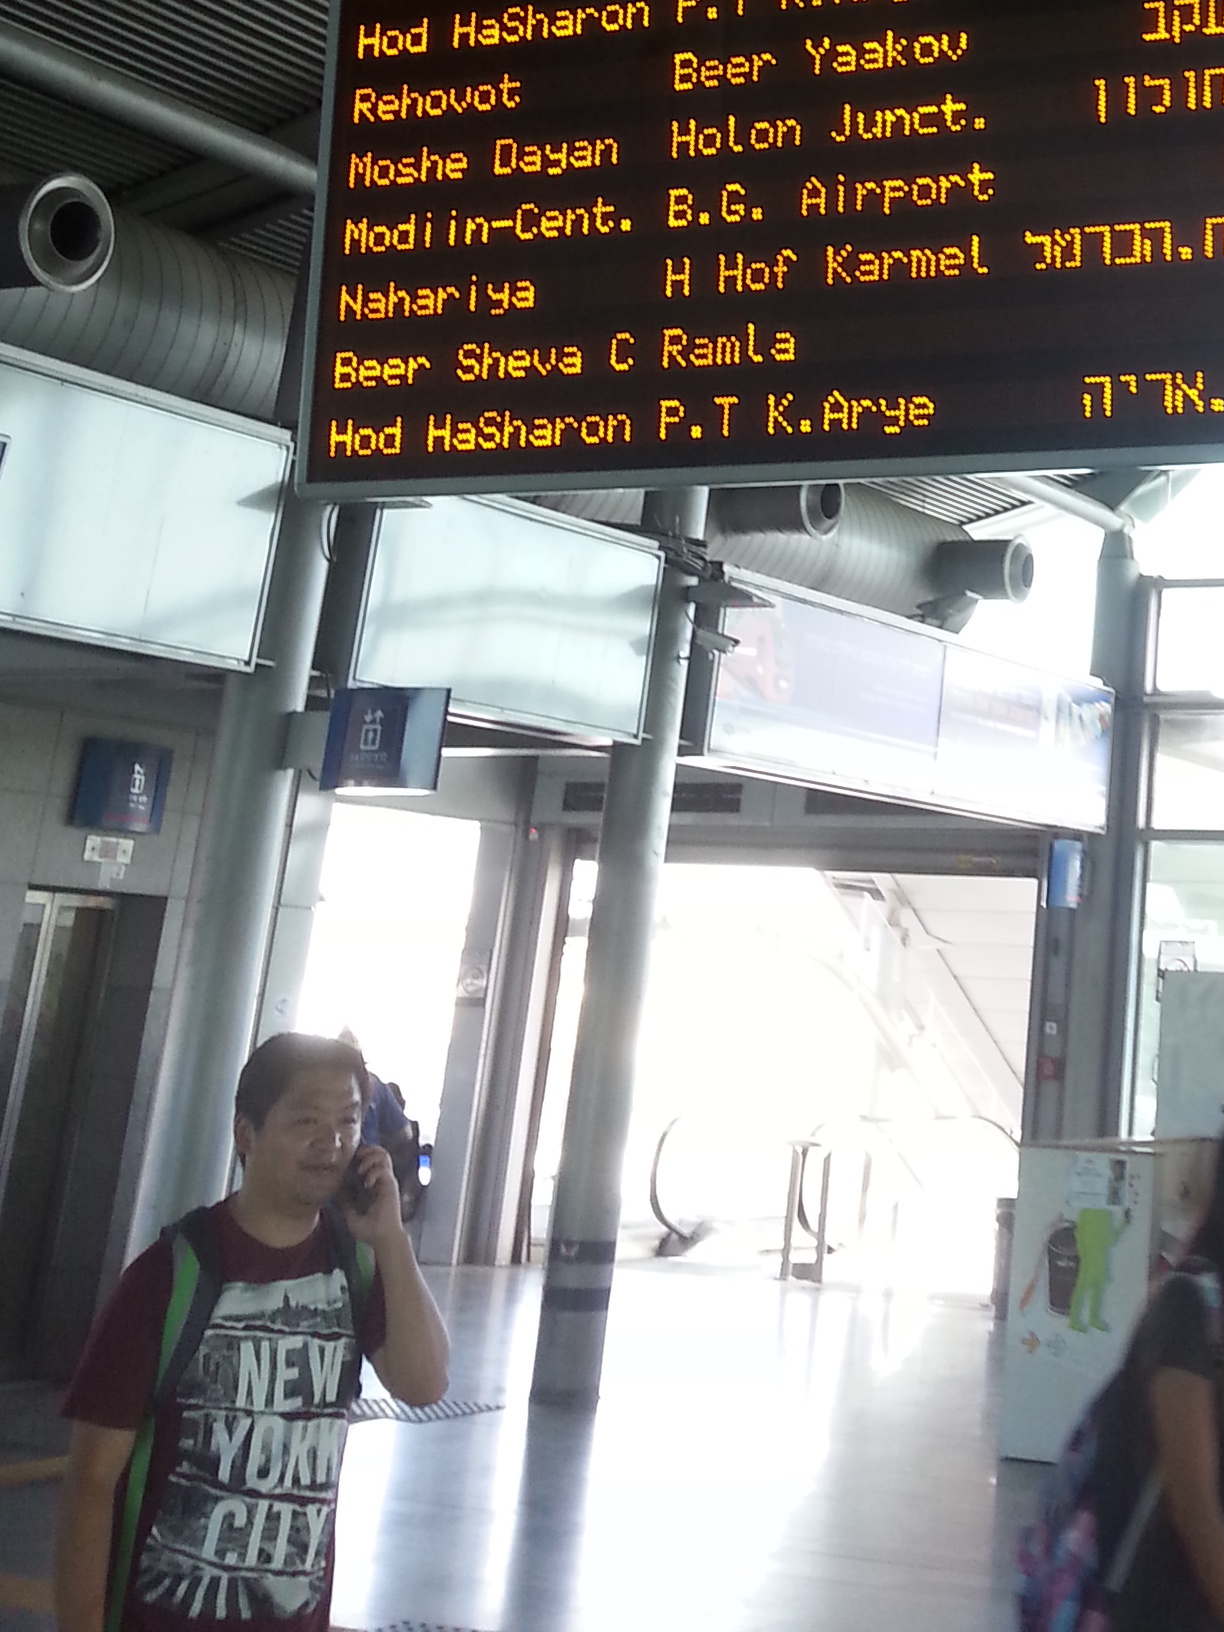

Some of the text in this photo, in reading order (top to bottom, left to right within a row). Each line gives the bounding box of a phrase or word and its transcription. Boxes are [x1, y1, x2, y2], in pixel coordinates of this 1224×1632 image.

[356, 0, 651, 61] Hod HaSharon
[672, 28, 969, 93] Beer Yaakov
[352, 72, 522, 125] Rehovot
[347, 136, 620, 190] Moshe Dayan
[670, 113, 803, 160] Holon
[799, 161, 996, 218] Airport
[664, 233, 990, 299] H Hof Karmel
[338, 274, 536, 323] Nahariya
[332, 331, 636, 390] Beer Sheva C
[660, 322, 797, 370] Ramla
[328, 409, 633, 459] Hod HaSharon
[235, 1336, 346, 1412] NEW
[201, 1499, 329, 1570] CITY
